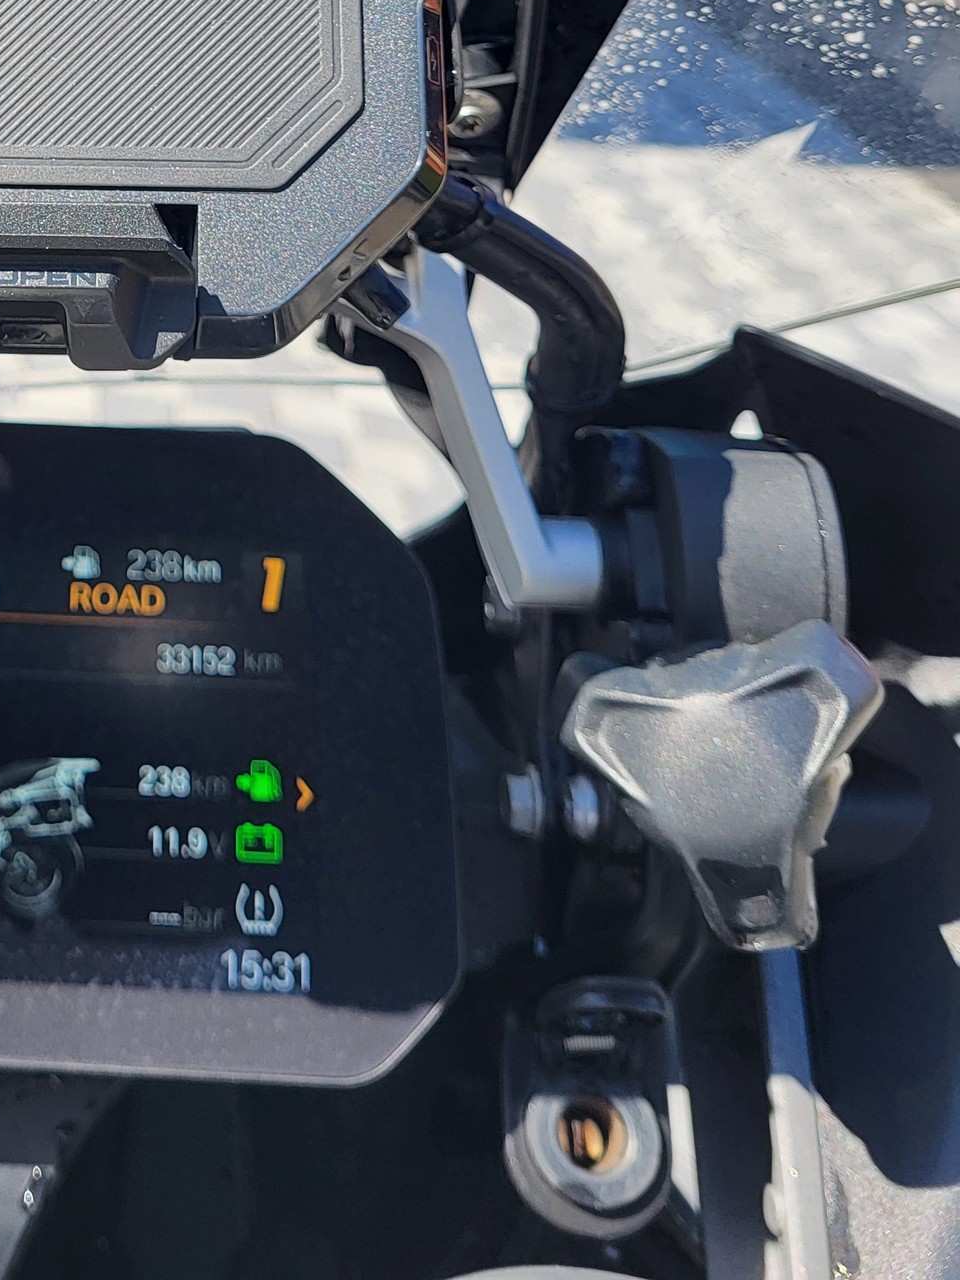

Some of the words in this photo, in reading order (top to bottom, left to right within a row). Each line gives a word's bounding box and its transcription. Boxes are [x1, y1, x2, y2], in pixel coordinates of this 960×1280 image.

[69, 580, 166, 617] ROAD
[260, 556, 286, 613] 1
[148, 824, 208, 860] 11.9
[220, 947, 311, 994] 15:31
